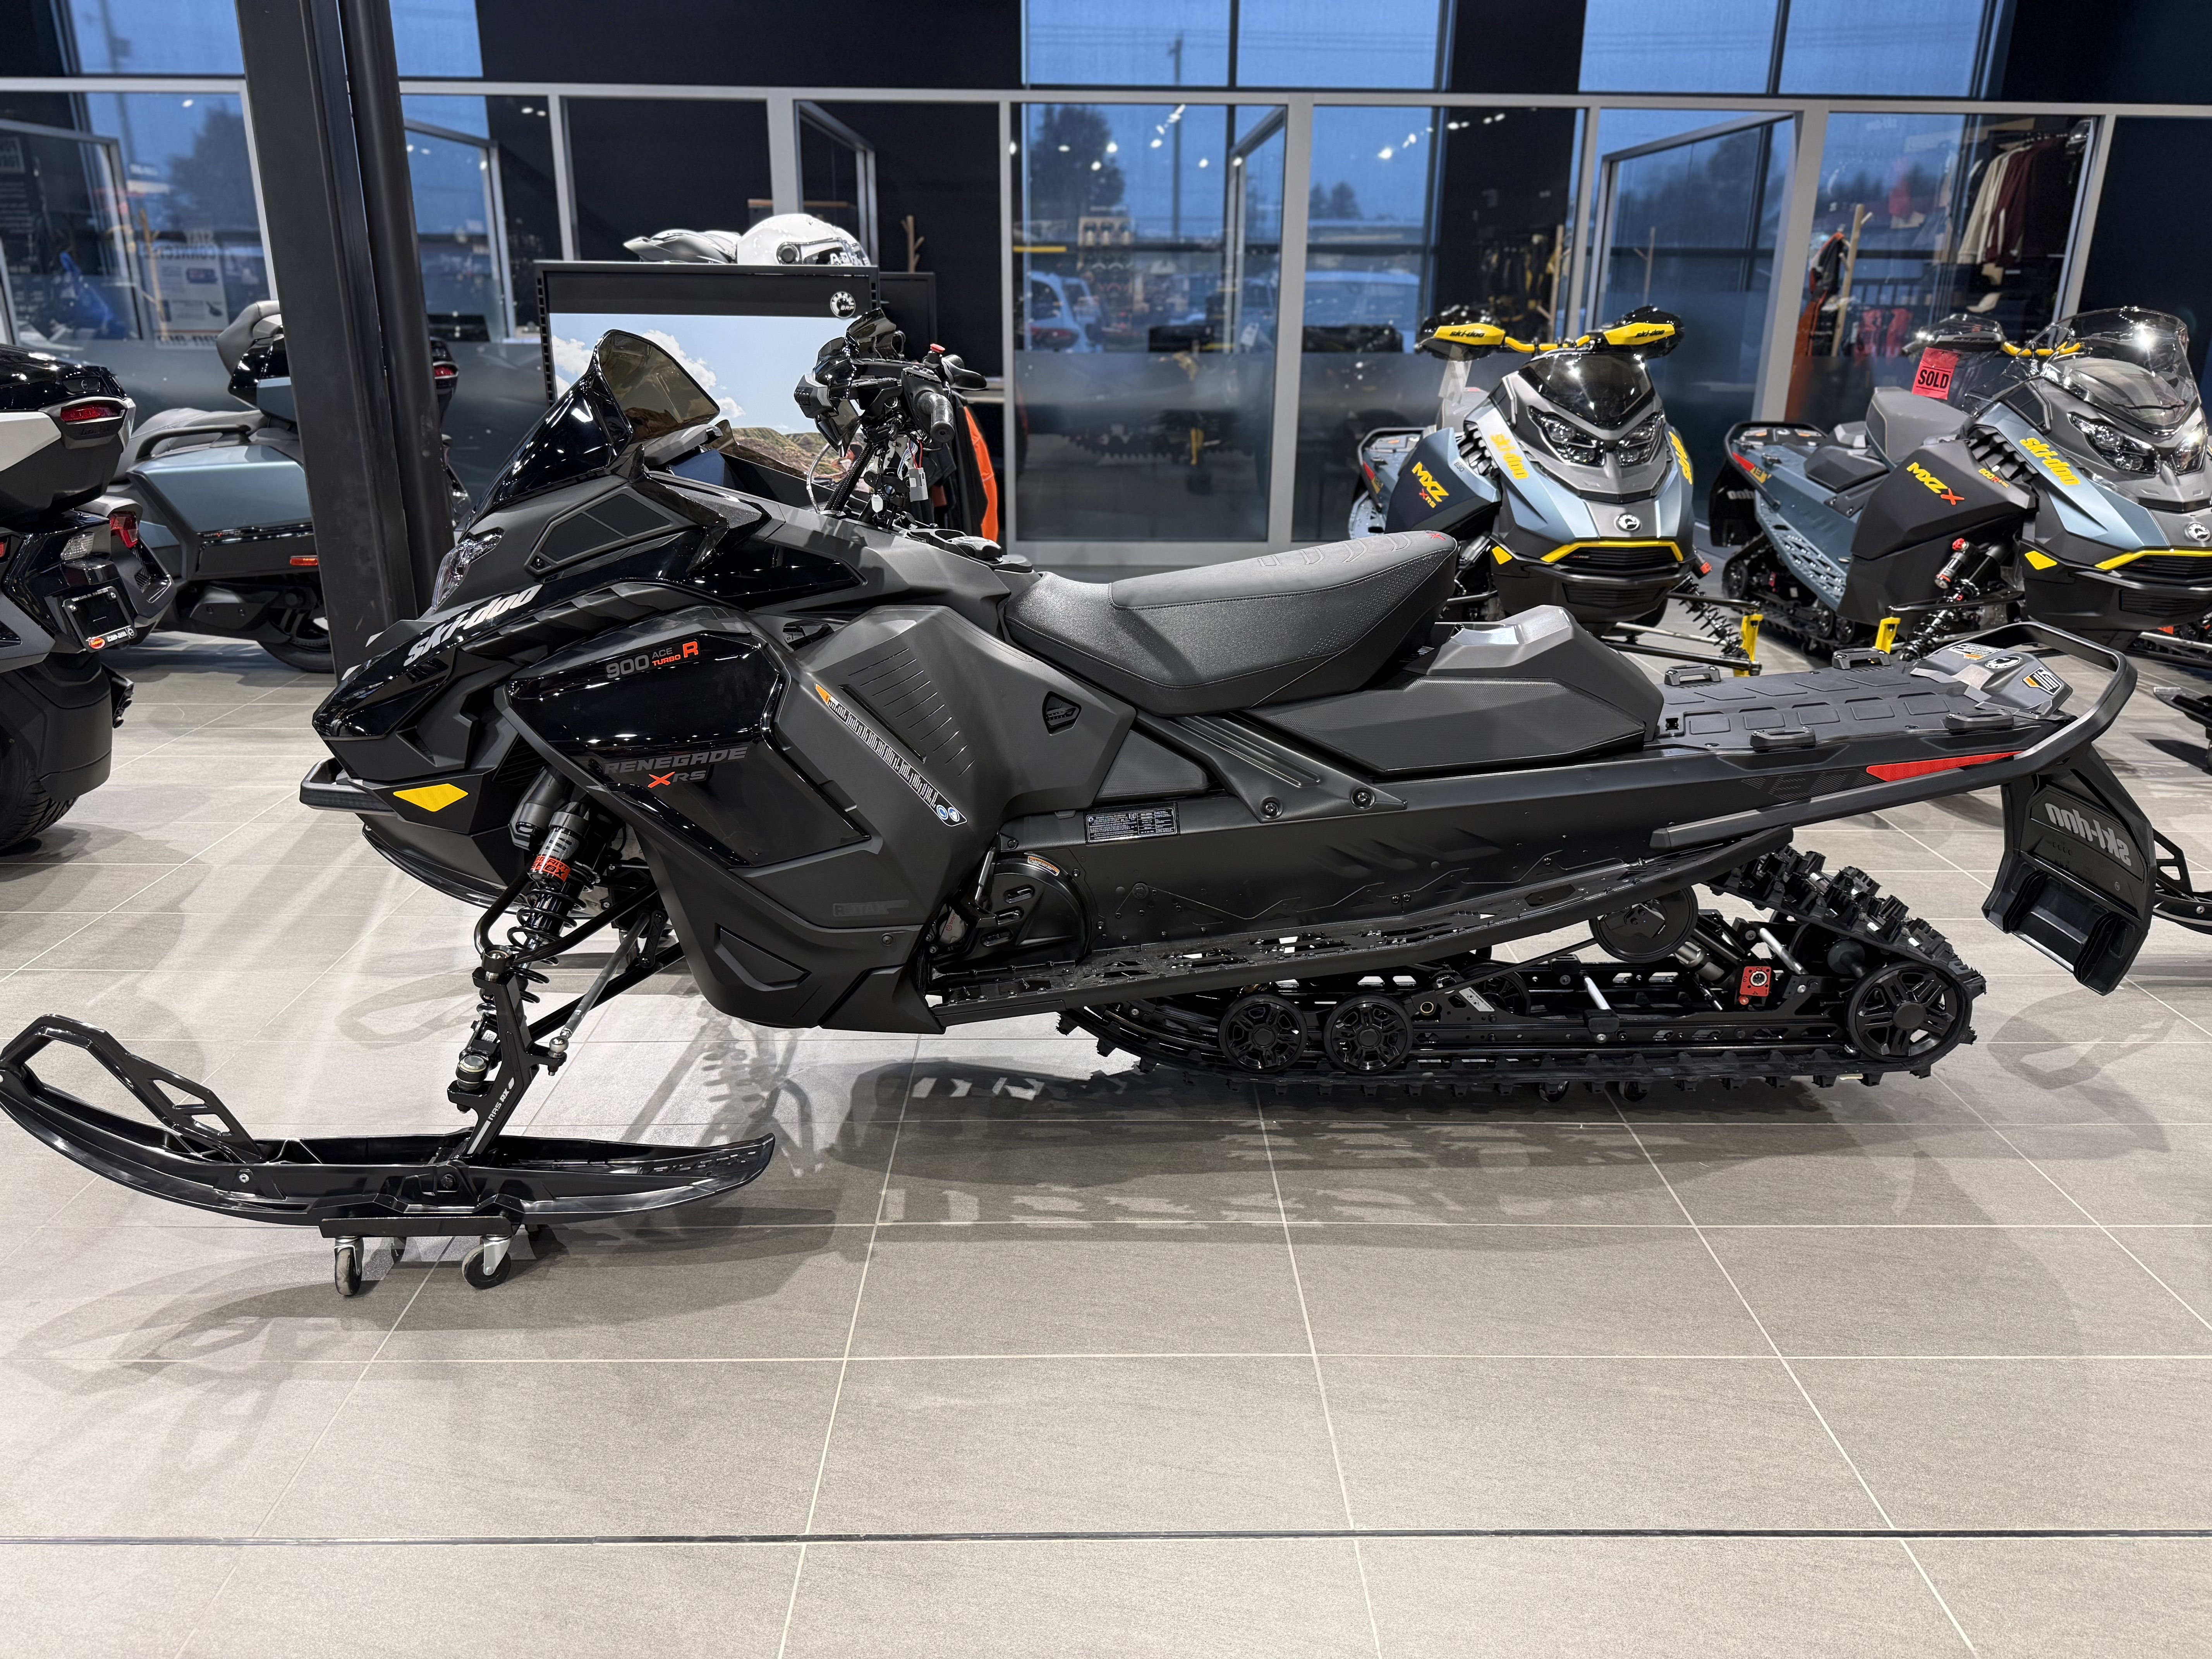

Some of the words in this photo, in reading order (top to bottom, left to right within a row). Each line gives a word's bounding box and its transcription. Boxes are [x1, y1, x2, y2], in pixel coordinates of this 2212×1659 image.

[1918, 369, 1949, 389] SOLD
[2020, 438, 2080, 486] ski-doo
[1412, 461, 1449, 502] MXZ
[1906, 462, 1948, 494] MXZ
[404, 584, 543, 667] ski-doo
[606, 654, 649, 678] 900
[652, 647, 673, 659] ACE
[652, 654, 681, 666] TURBO
[682, 641, 699, 658] R
[604, 747, 748, 775] RENEGADE
[488, 1101, 502, 1121] RAS
[499, 1088, 510, 1103] RX
